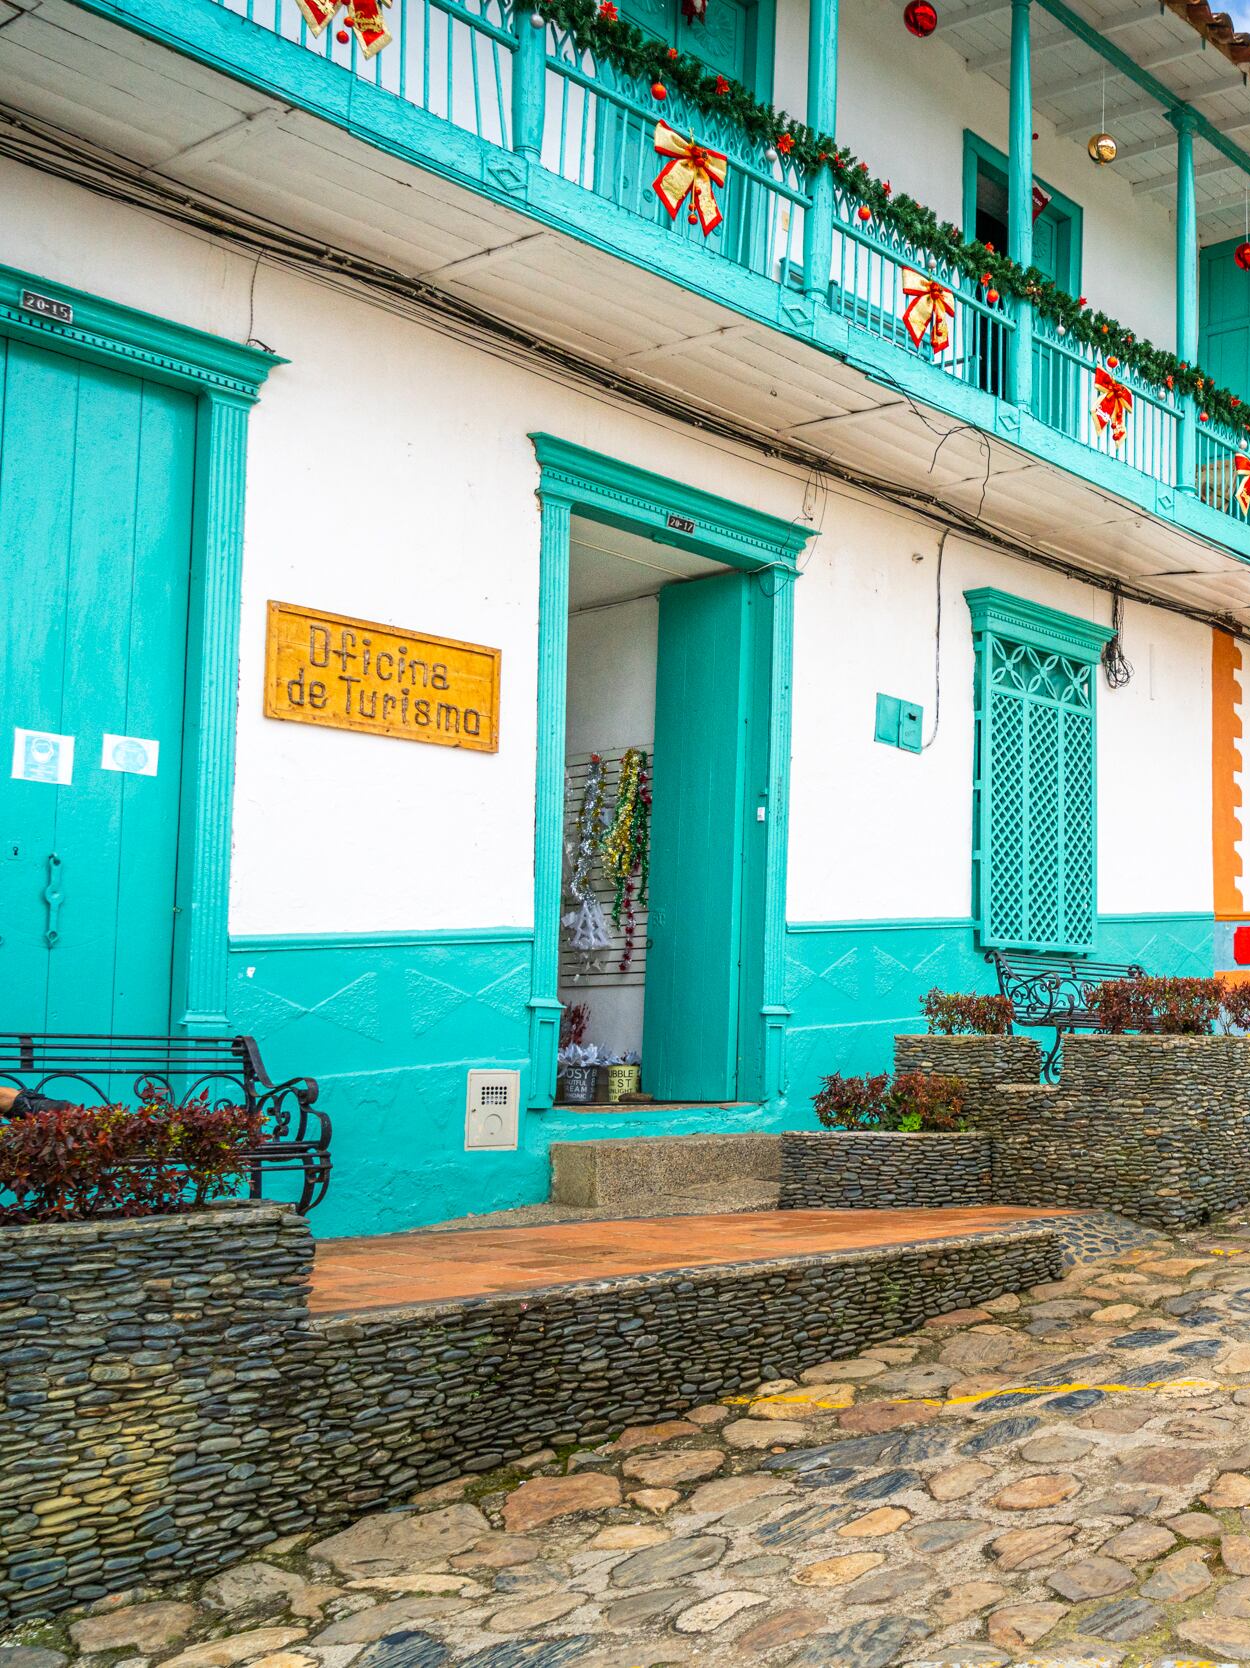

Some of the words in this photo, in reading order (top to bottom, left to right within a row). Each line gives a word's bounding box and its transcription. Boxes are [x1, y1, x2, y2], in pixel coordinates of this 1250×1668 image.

[26, 295, 68, 318] 20-15
[670, 517, 694, 532] 20-17
[309, 624, 450, 690] Oficina
[287, 667, 328, 709] de
[338, 674, 480, 735] Turismo
